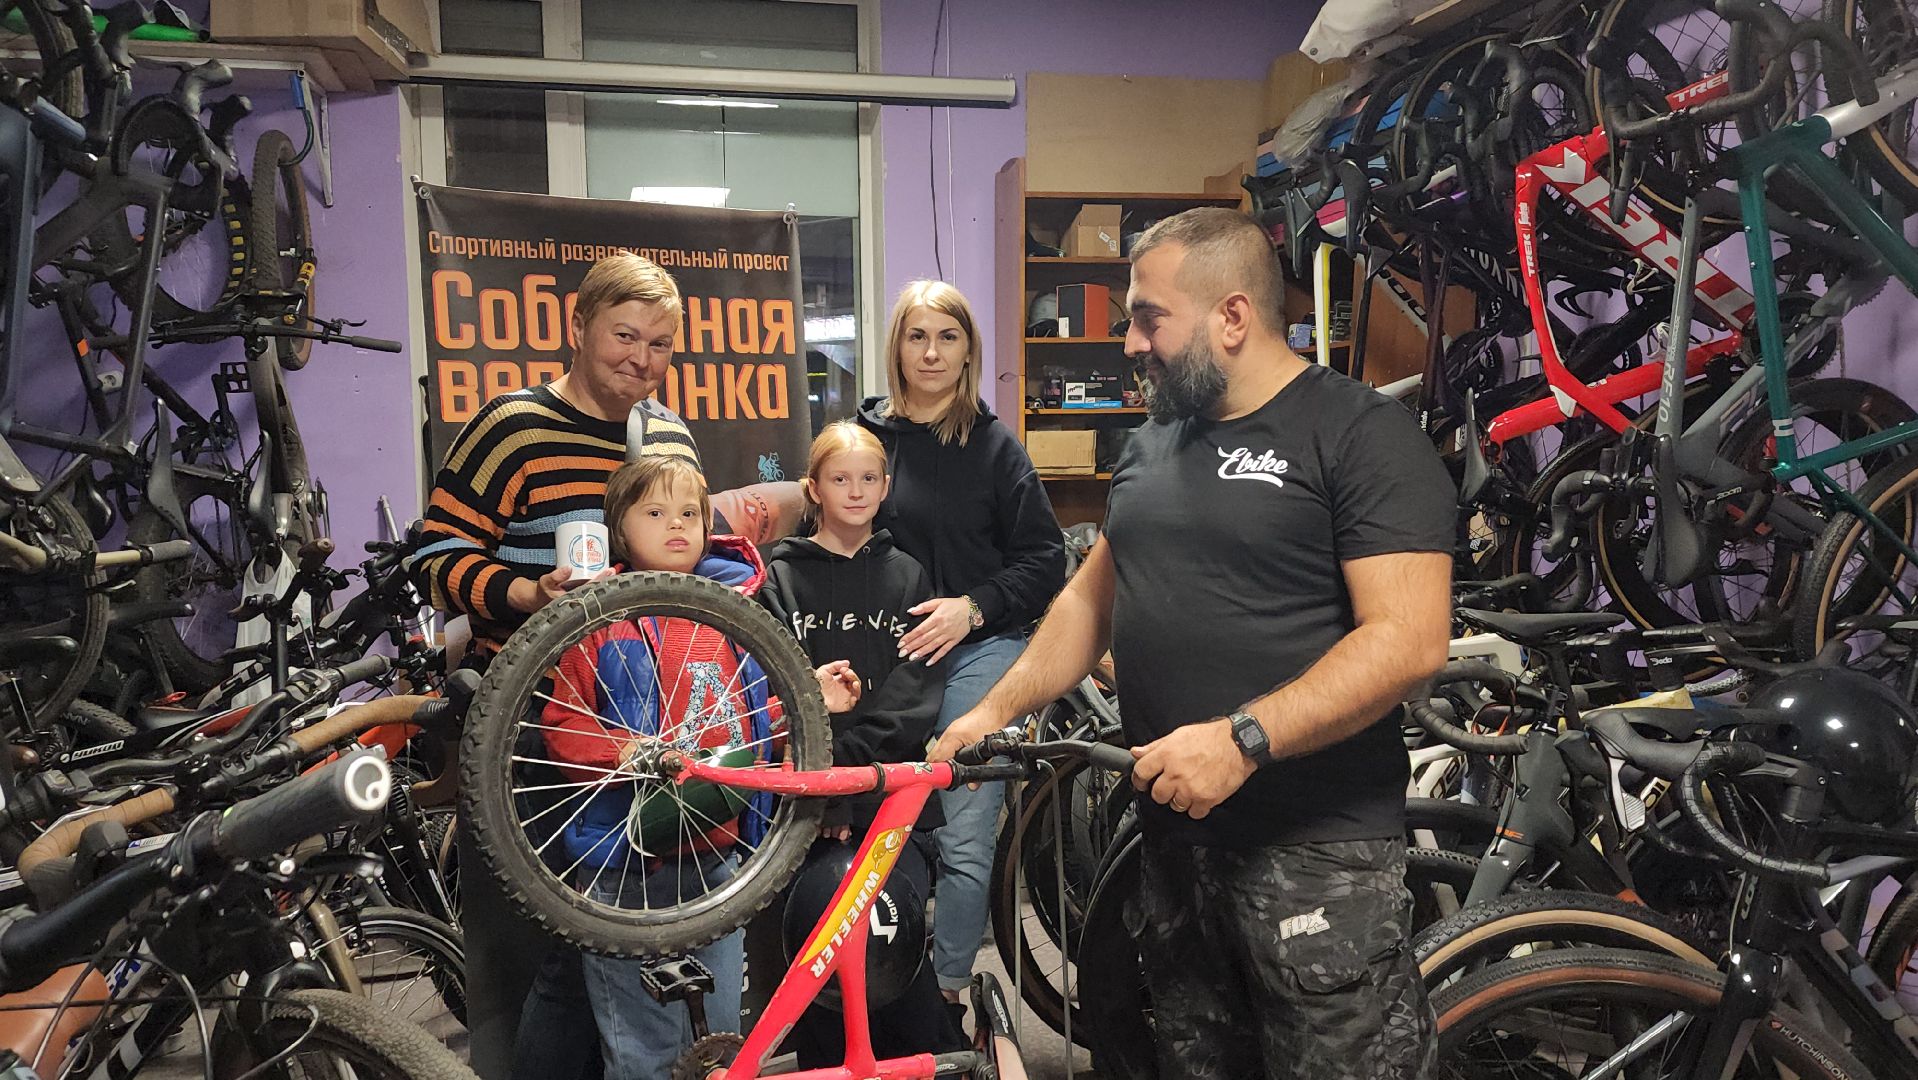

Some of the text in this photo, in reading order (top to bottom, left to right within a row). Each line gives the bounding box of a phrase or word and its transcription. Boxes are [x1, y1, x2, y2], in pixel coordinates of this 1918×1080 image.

[429, 230, 790, 273] Спортивный развлательный проект
[1522, 232, 1536, 278] TREK
[432, 269, 796, 354] Собная
[1218, 446, 1289, 489] Ebike
[810, 869, 881, 979] WHEELER
[1279, 906, 1331, 940] FOX
